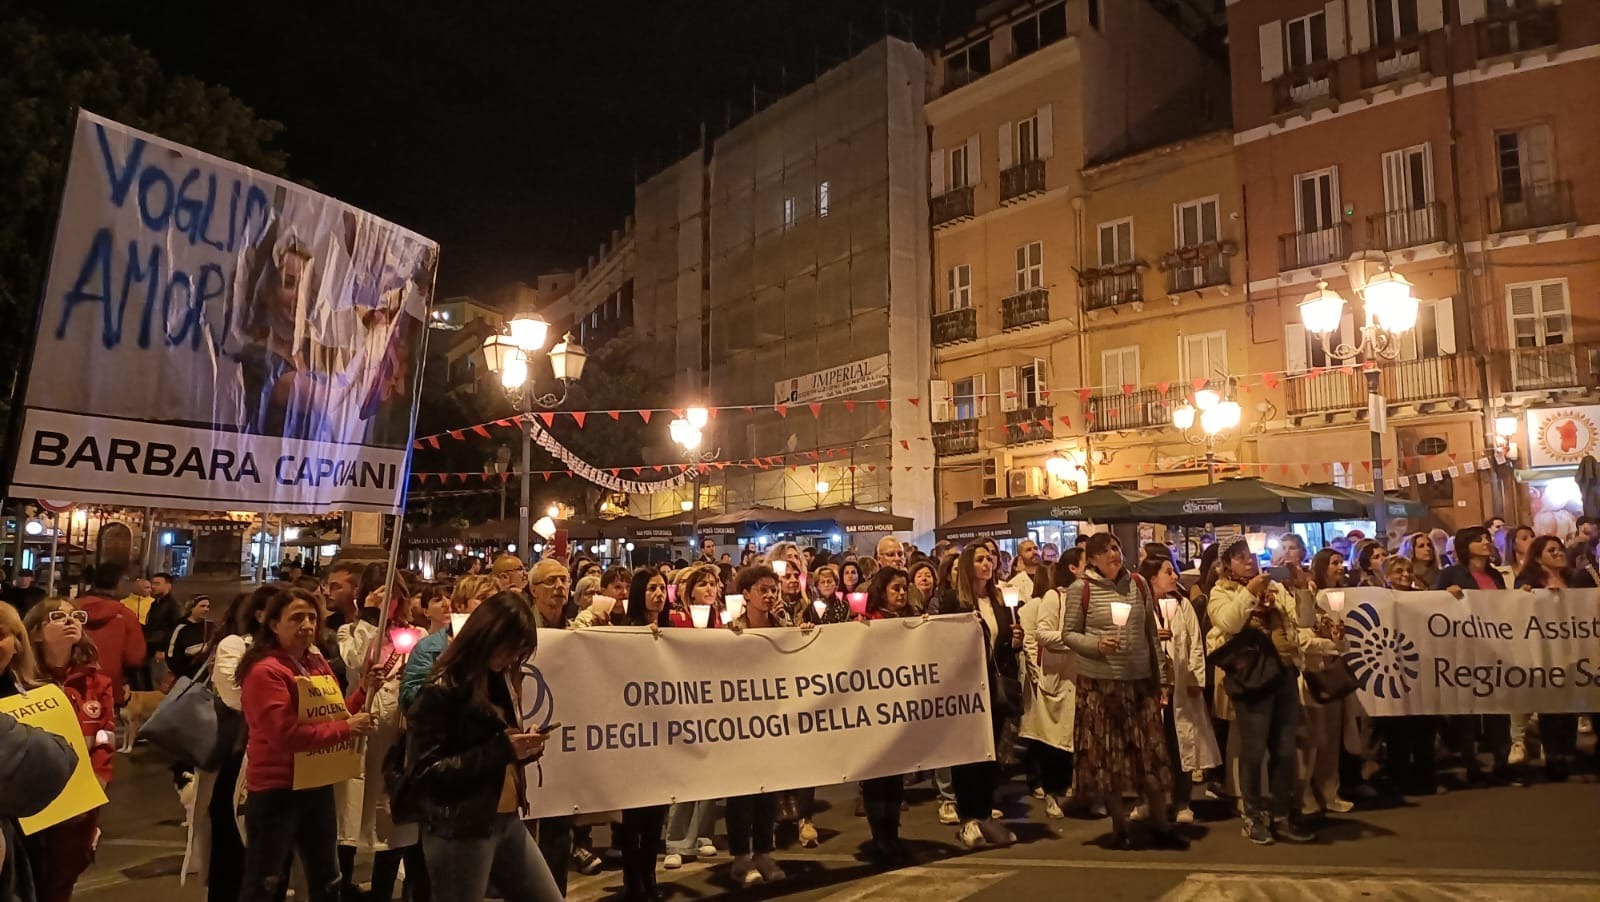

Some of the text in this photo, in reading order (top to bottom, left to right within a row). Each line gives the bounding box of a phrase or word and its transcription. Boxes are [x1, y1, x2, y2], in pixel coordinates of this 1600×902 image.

[96, 122, 270, 254] VOGLIO
[54, 229, 231, 357] AMOR
[813, 361, 871, 389] IMPERIAL
[29, 430, 396, 490] BARBARA CAPOVANI
[1427, 613, 1600, 640] Ordine Assist
[308, 687, 321, 698] NO
[623, 663, 940, 707] ORDINE DELLE PSICOLOGHE
[1434, 657, 1565, 697] Regione
[9, 697, 60, 720] TATECI
[306, 703, 347, 718] VIOLENZ
[562, 692, 986, 752] E DEGLI PSICOLOGI DELLA SARDEGNA
